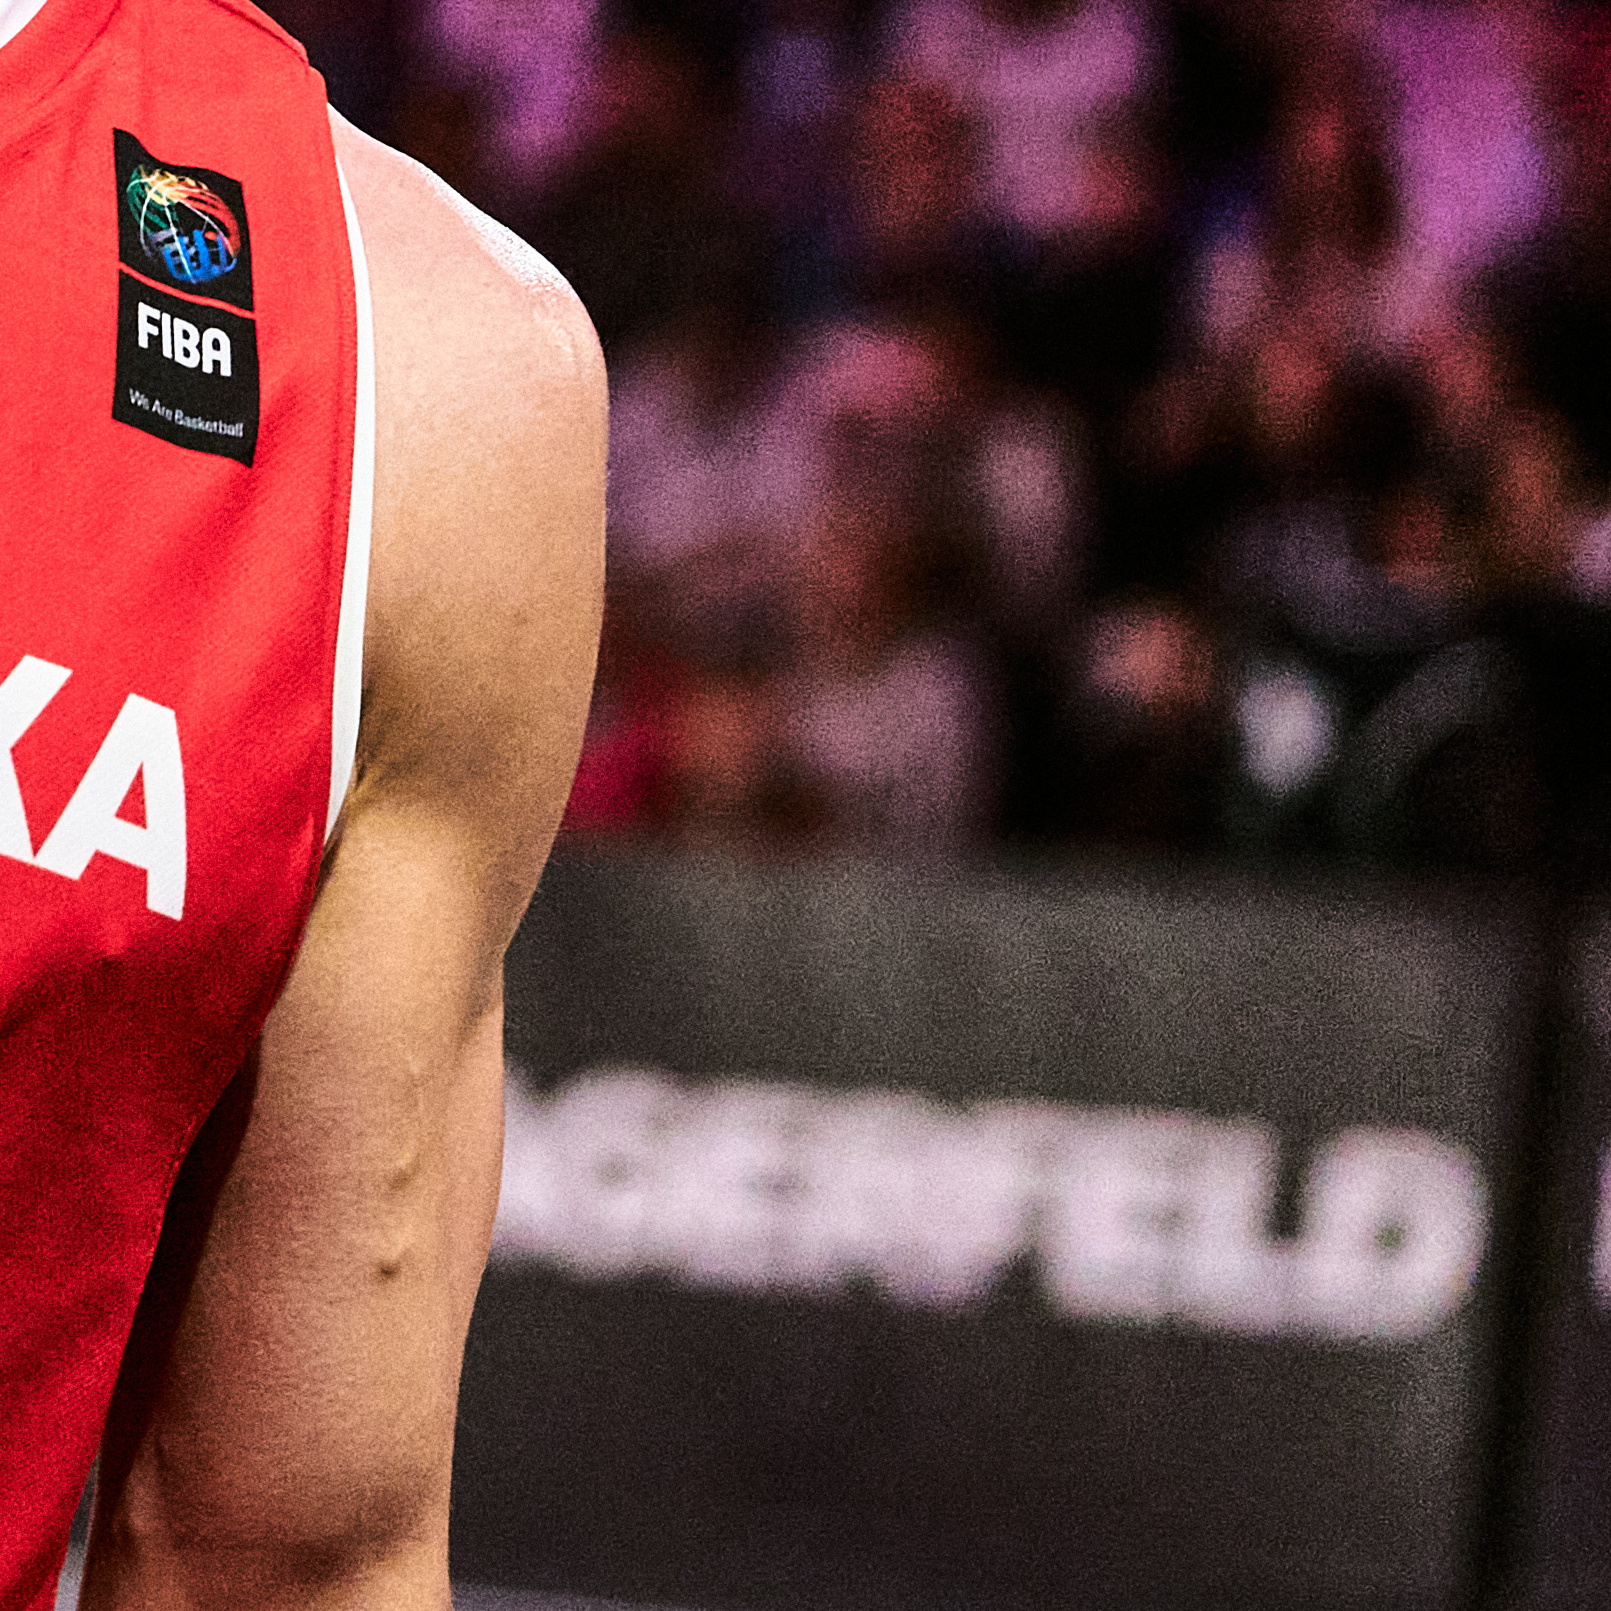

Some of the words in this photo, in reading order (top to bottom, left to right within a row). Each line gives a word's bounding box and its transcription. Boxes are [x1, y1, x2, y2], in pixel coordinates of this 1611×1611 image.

[138, 301, 232, 377] FIBA
[128, 387, 150, 410] We
[151, 399, 174, 422] Are
[174, 408, 245, 439] Basketball
